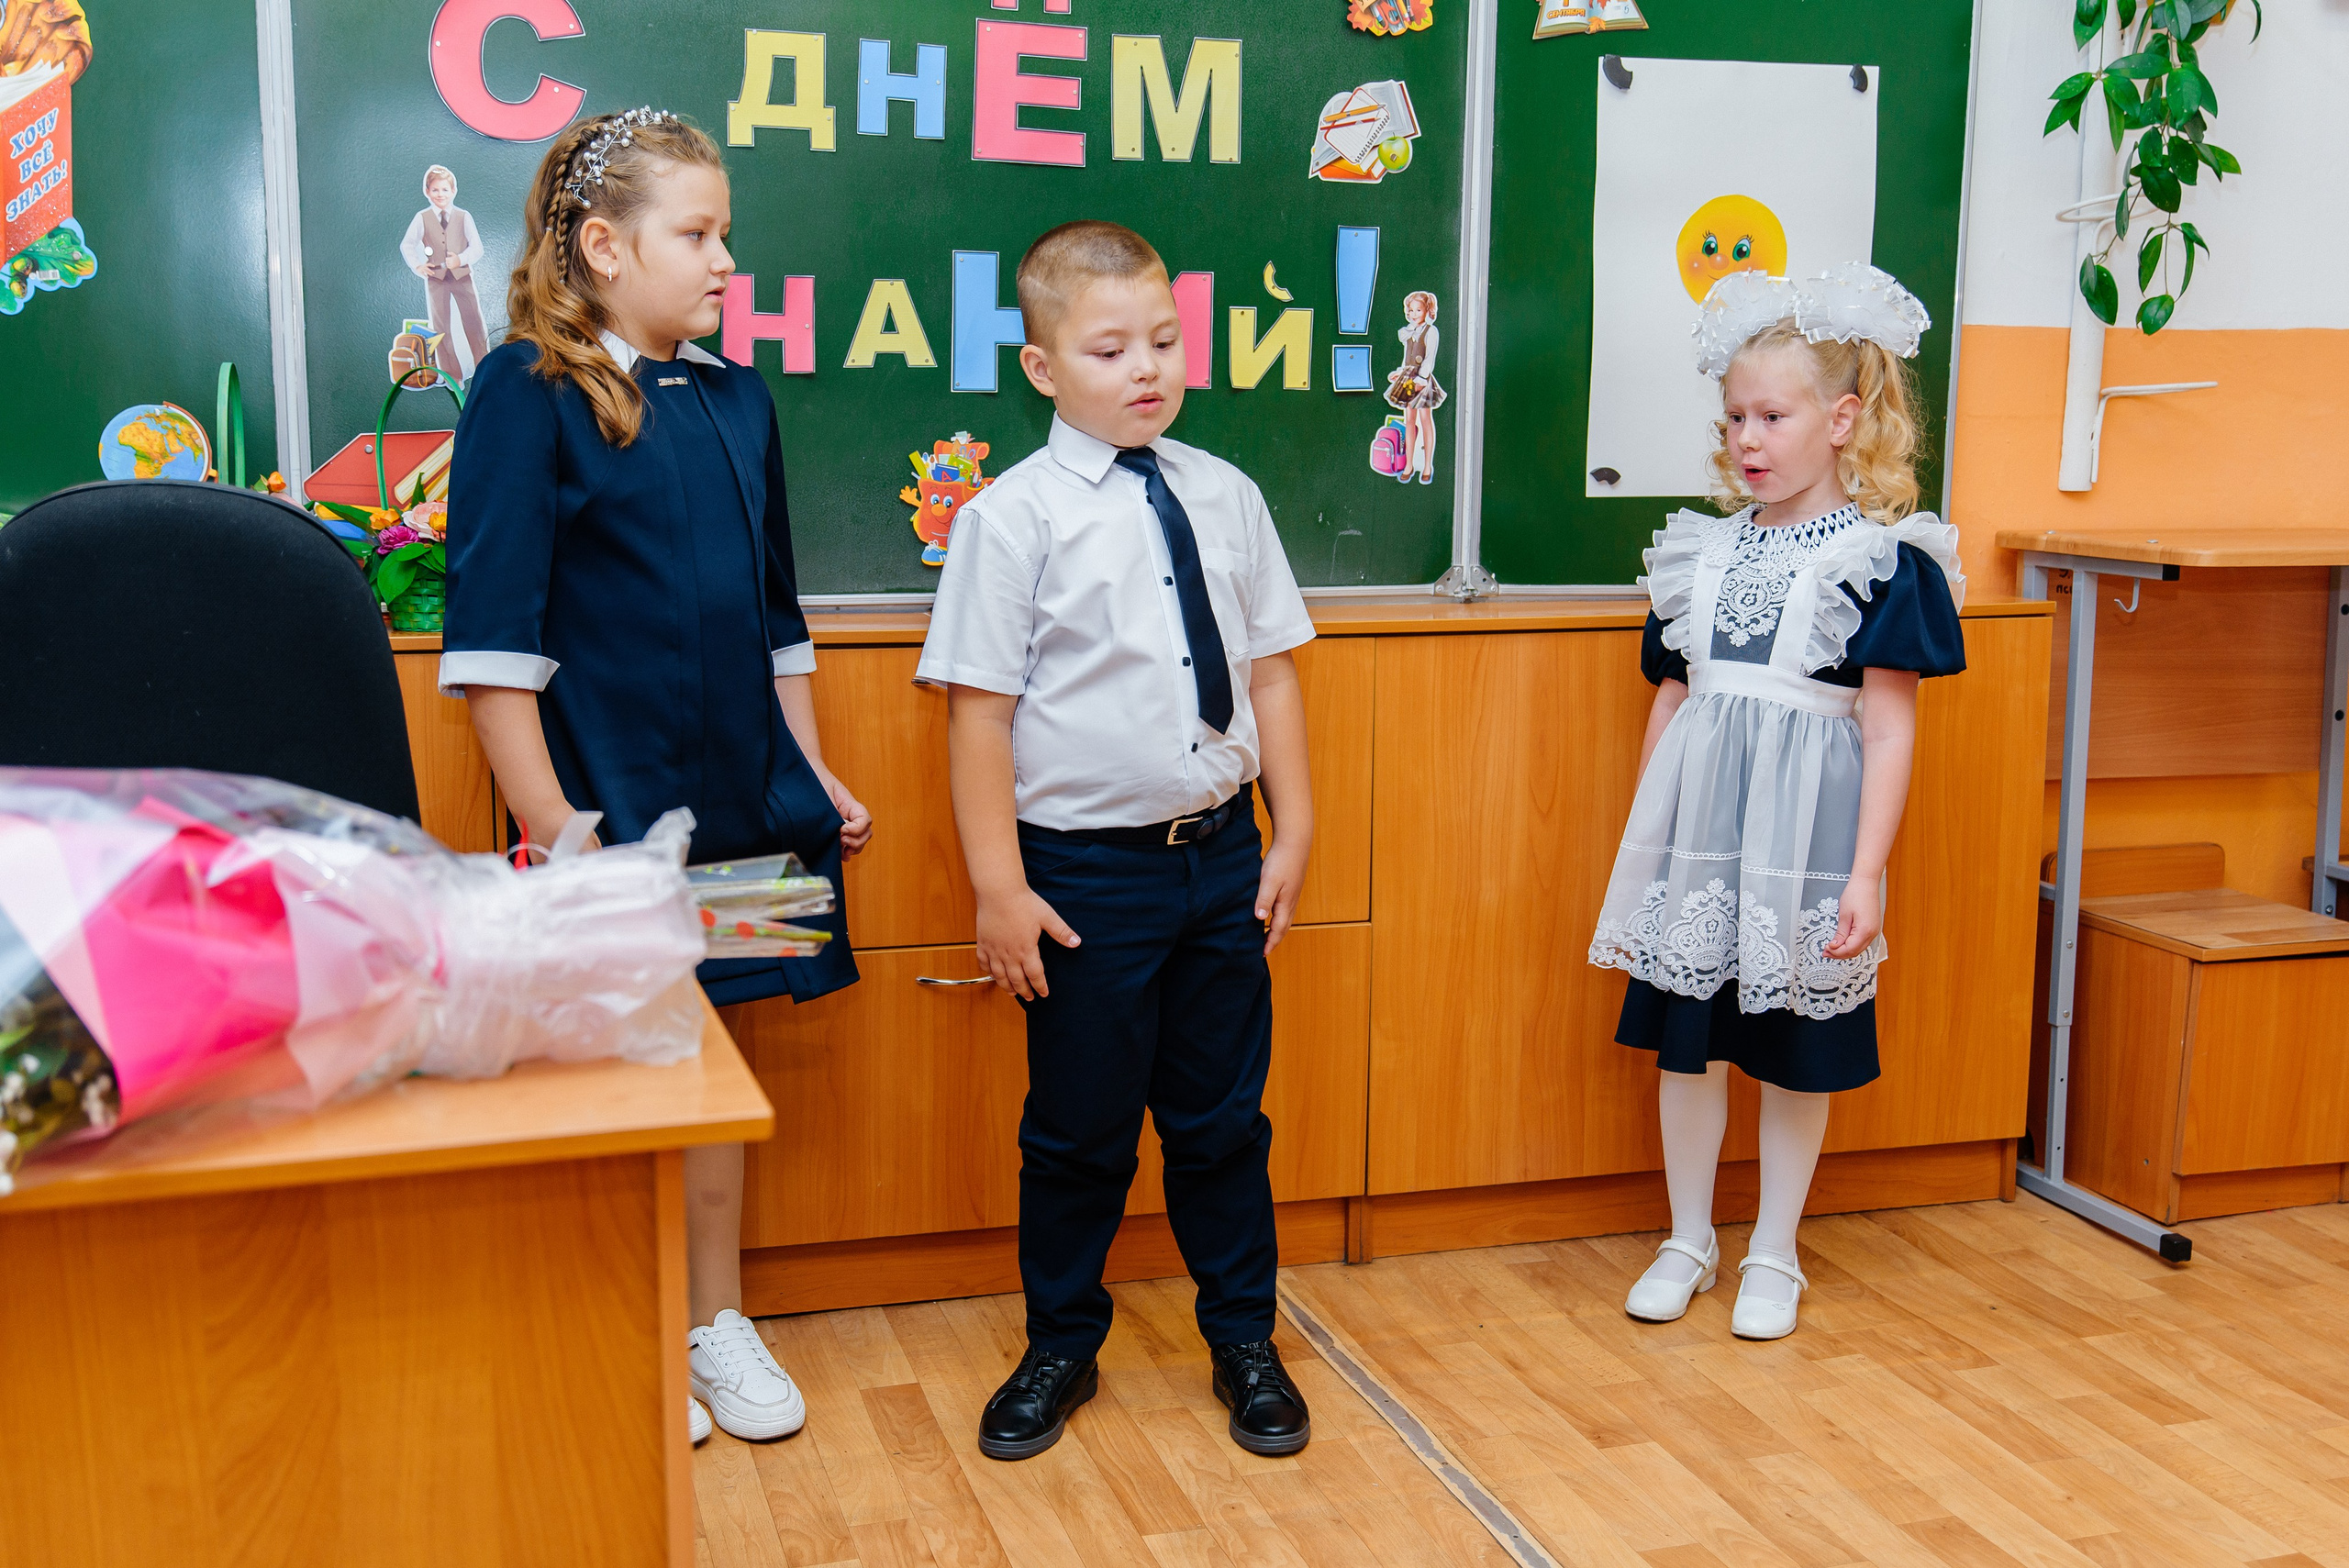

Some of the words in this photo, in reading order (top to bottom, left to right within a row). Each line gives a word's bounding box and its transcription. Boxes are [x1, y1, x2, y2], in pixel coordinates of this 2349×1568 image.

[1546, 8, 1586, 19] СЕНТЯБРЯ
[429, 0, 588, 143] С
[727, 0, 1243, 168] ДНЁМ
[10, 107, 59, 159] ХОЧУ
[19, 139, 53, 183] ВСЁ
[6, 159, 68, 222] ЗНАТЬ!
